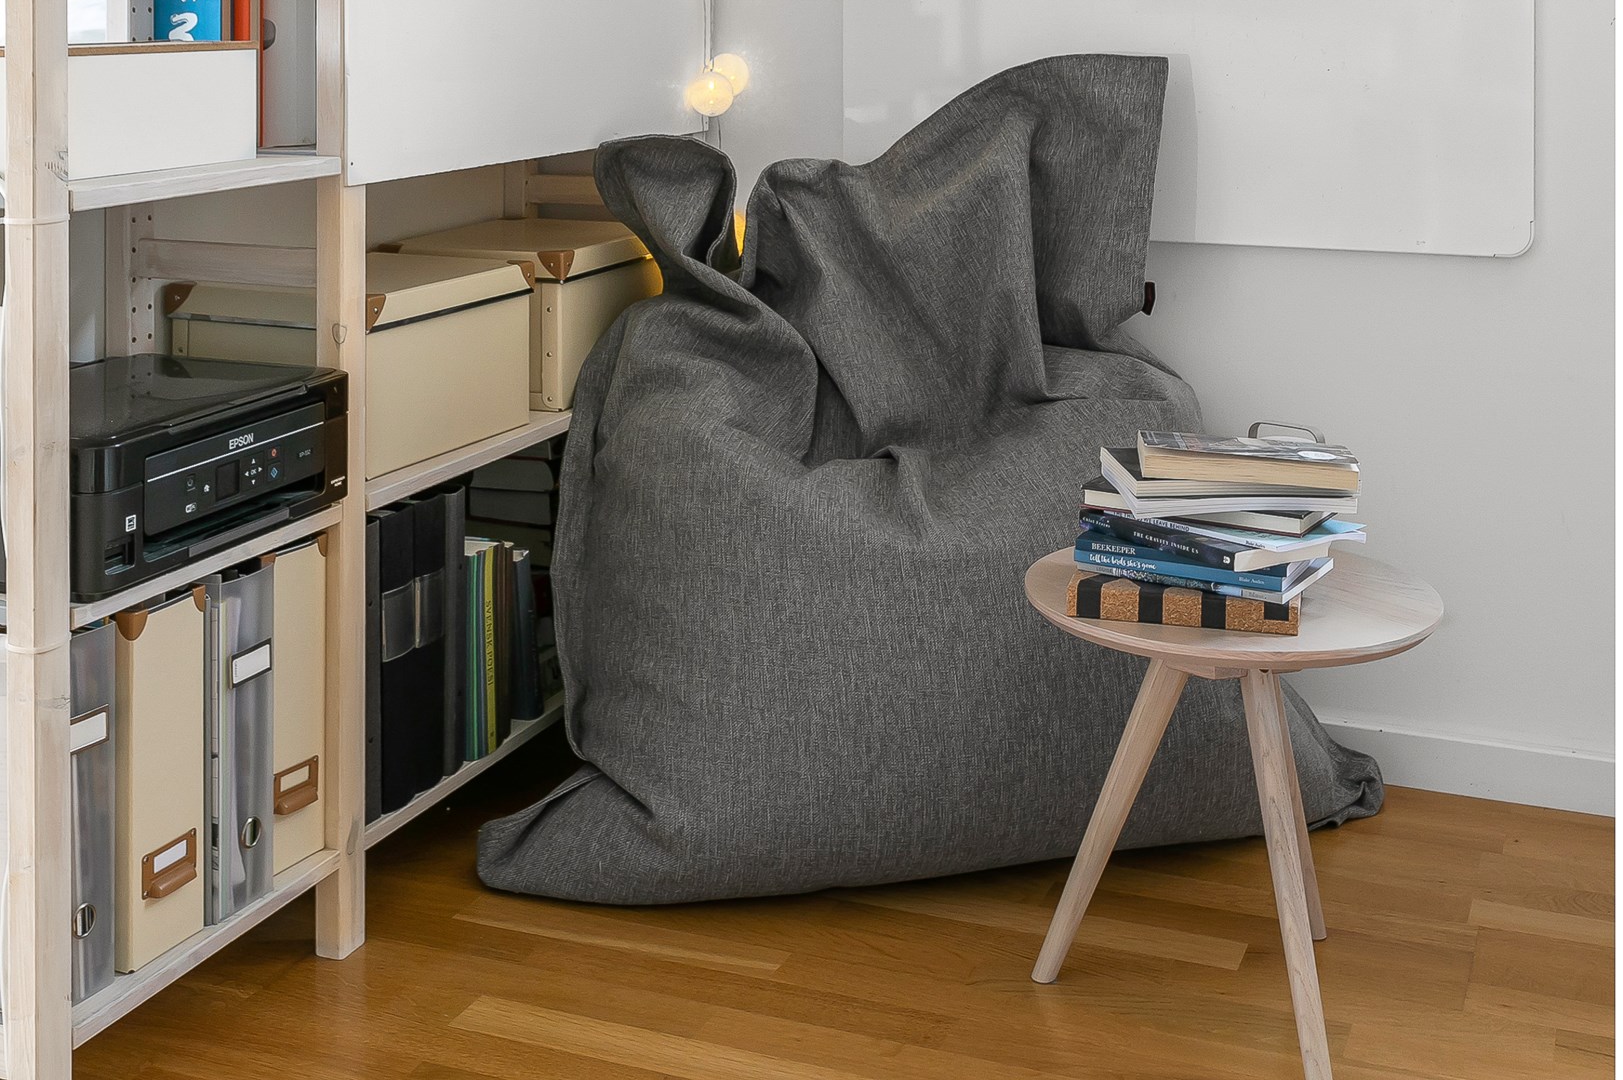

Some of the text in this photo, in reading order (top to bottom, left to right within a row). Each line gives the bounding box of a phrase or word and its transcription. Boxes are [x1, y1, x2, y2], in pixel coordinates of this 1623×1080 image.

[228, 432, 255, 451] EPSON
[1091, 542, 1136, 555] BEEKEEPER
[1133, 531, 1144, 539] THE
[1145, 532, 1169, 546] GRAVITY
[1170, 541, 1190, 552] INSIDE
[1089, 553, 1101, 563] tell
[1100, 554, 1111, 564] the
[1141, 563, 1157, 571] gone
